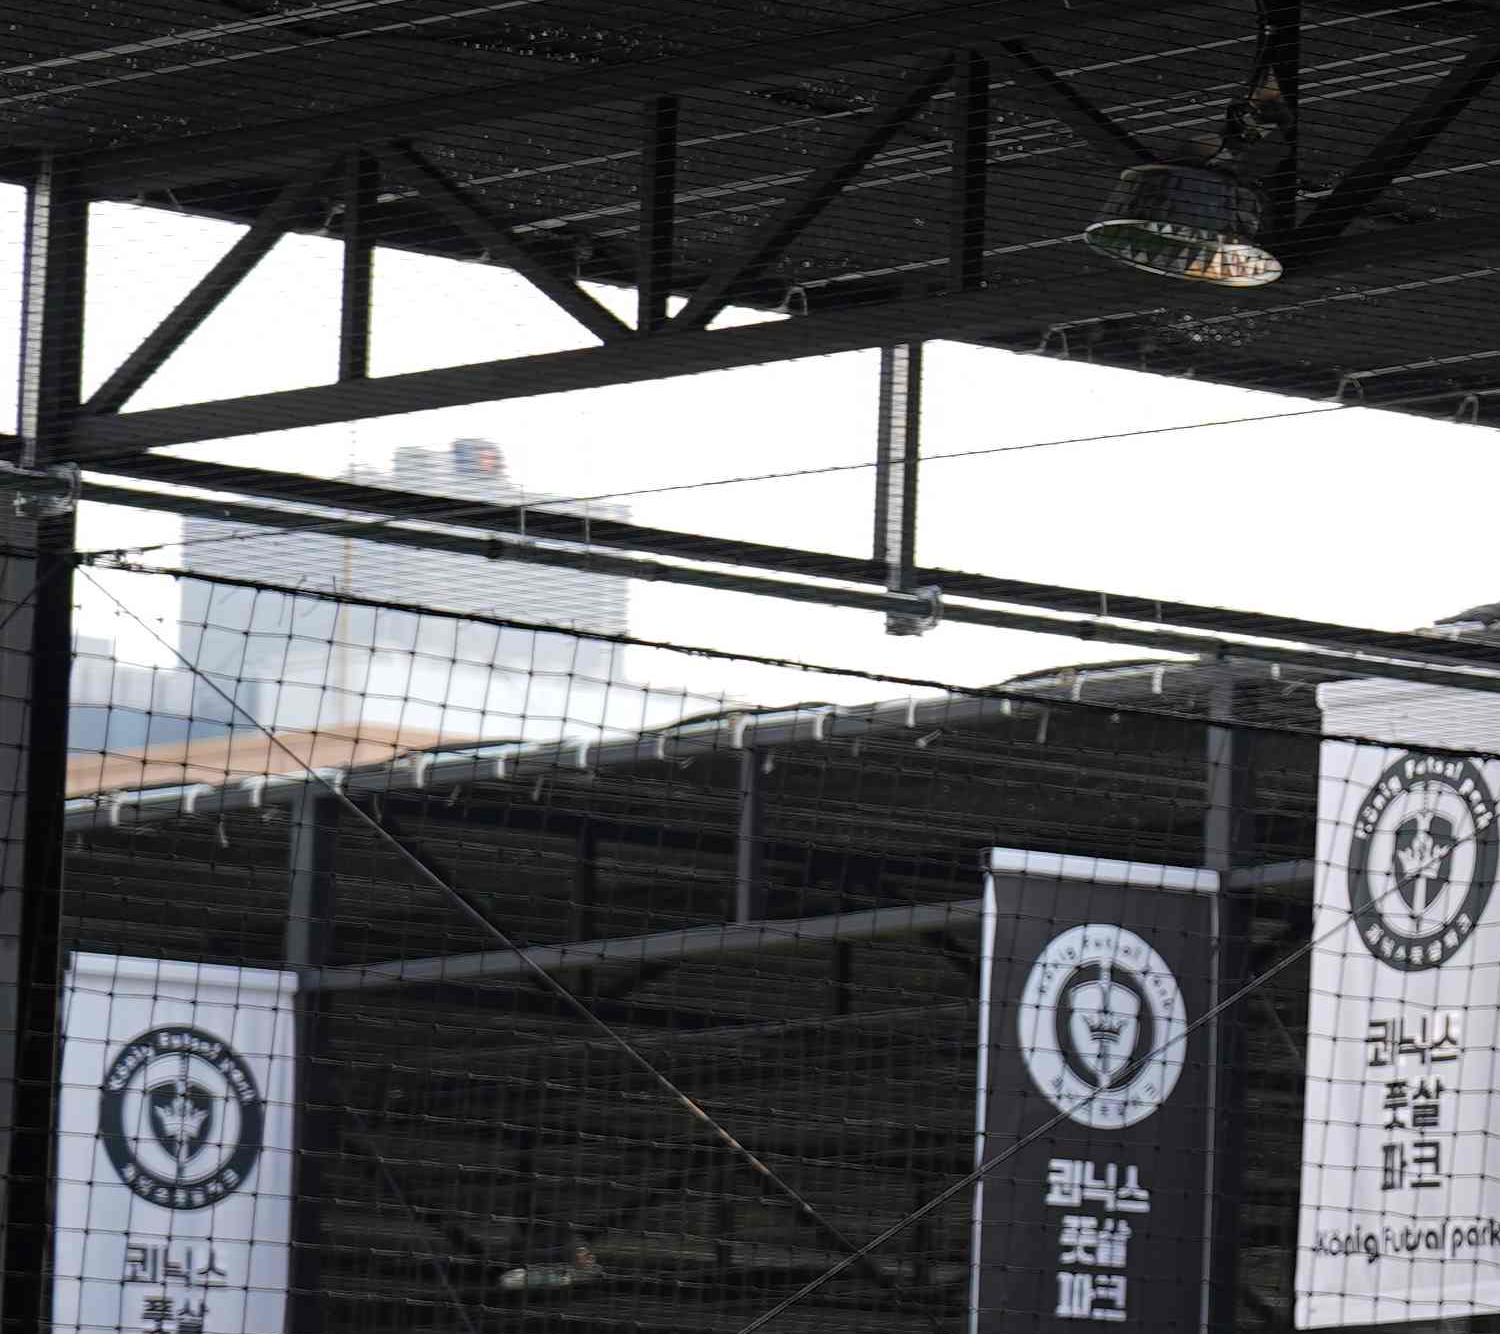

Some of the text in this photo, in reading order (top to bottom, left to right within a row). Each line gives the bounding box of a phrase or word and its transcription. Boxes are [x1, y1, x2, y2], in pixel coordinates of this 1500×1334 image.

[1384, 1078, 1443, 1129] 풋살
[1381, 1141, 1442, 1190] 파크
[1058, 1215, 1132, 1267] 풋살
[1055, 1271, 1128, 1323] 파크
